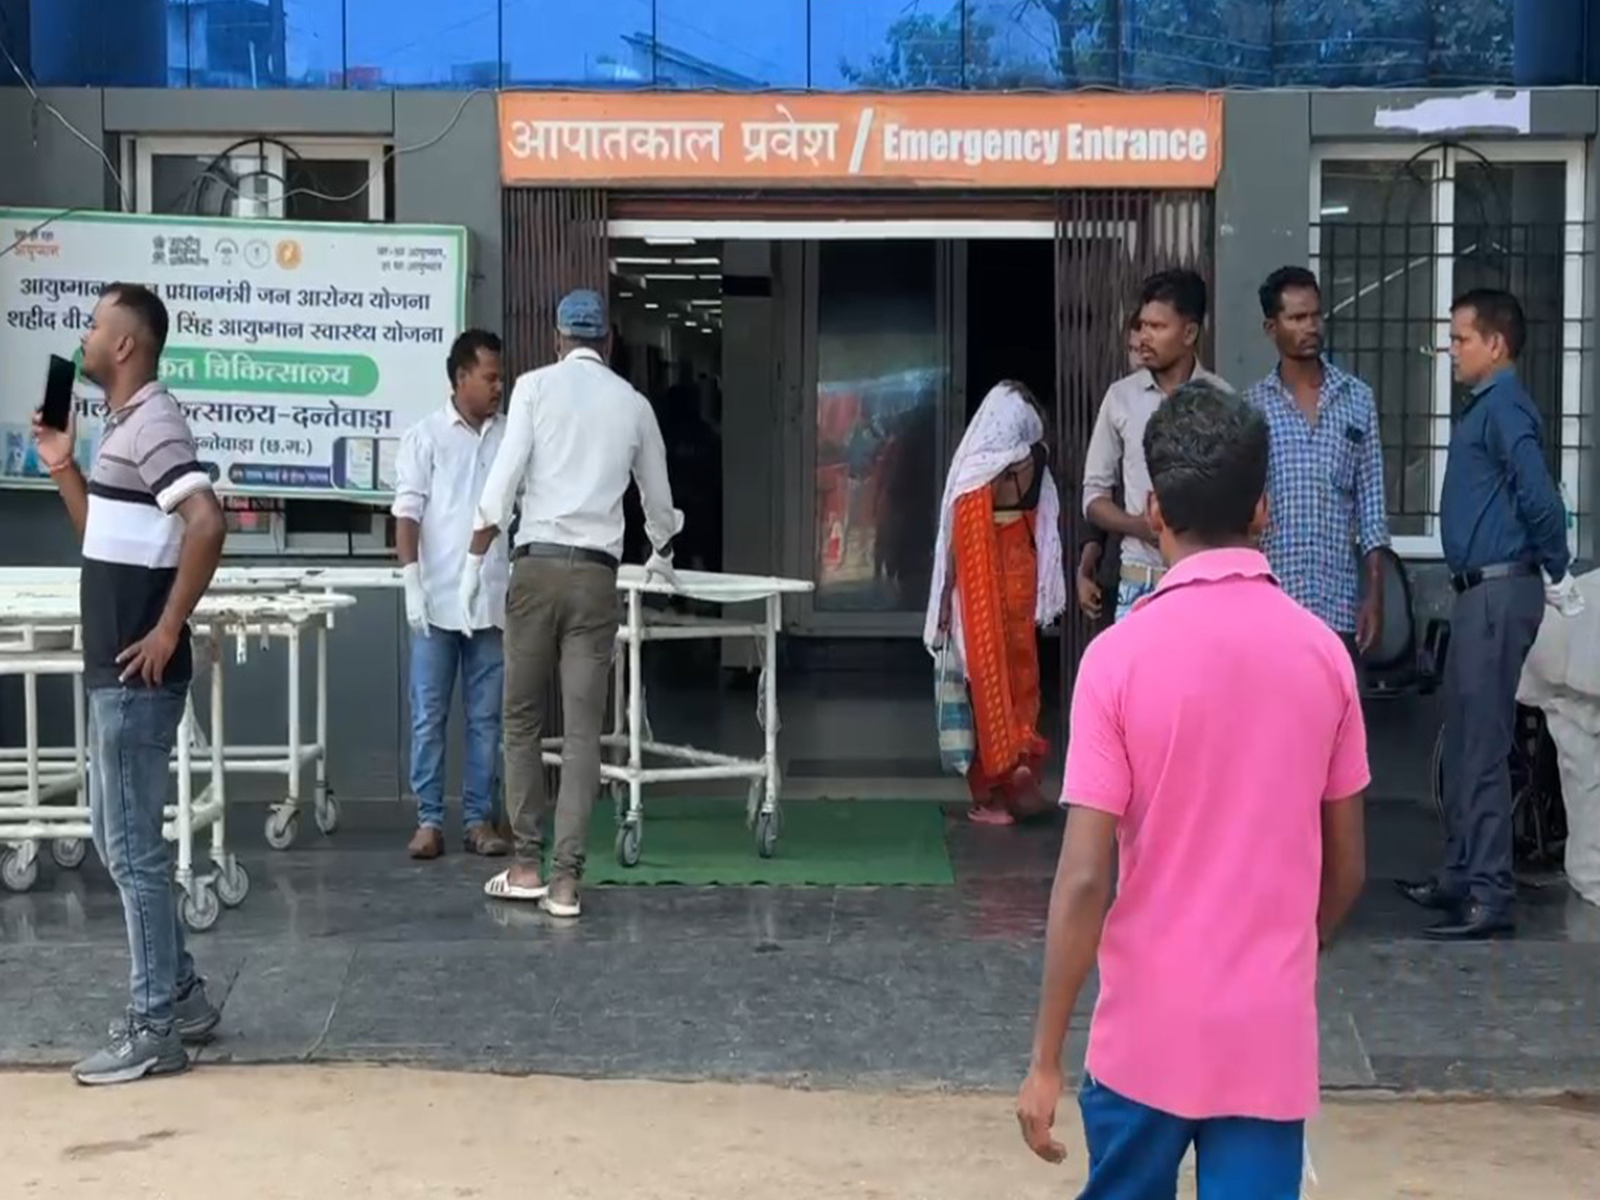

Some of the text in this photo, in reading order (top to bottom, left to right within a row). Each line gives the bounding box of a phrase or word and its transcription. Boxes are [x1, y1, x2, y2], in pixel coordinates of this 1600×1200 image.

[507, 120, 724, 163] आपातकाल
[741, 103, 839, 167] प्रवेश
[883, 122, 1207, 165] Emergency Entrance
[166, 279, 252, 304] प्रधानमंत्री
[257, 287, 291, 306] जन
[297, 284, 364, 308] आरोग्य
[369, 286, 431, 310] योजना
[7, 304, 57, 331] शहीद
[177, 310, 213, 336] सिंह
[218, 318, 304, 344] आयुष्मान
[310, 322, 376, 342] स्वास्थ्य
[382, 319, 444, 343] योजना
[204, 352, 351, 386] चिकित्सालय
